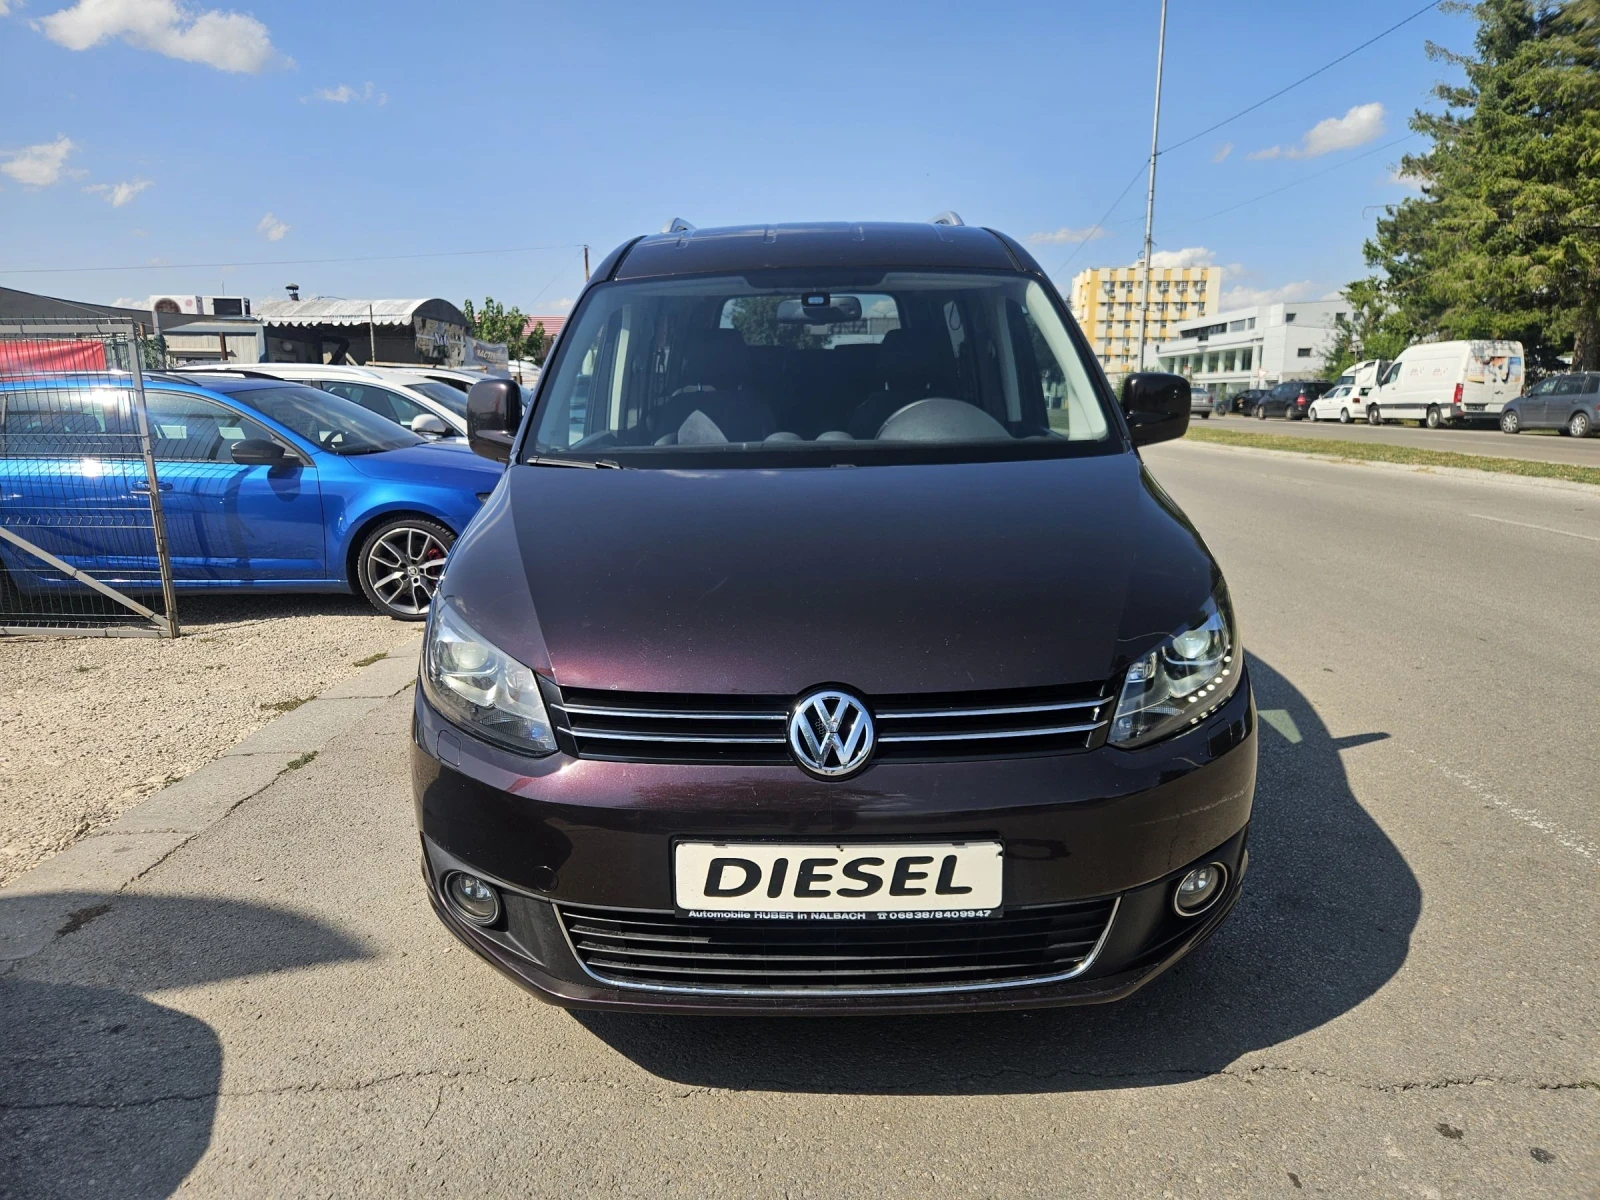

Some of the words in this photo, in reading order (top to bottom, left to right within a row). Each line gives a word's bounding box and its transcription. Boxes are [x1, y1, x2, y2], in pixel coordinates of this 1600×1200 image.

[794, 691, 869, 772] VW
[703, 854, 973, 899] DIESEL
[688, 910, 751, 919] Automobile
[753, 911, 794, 920] HUBER
[797, 911, 808, 920] in
[810, 911, 866, 920] NALBACH
